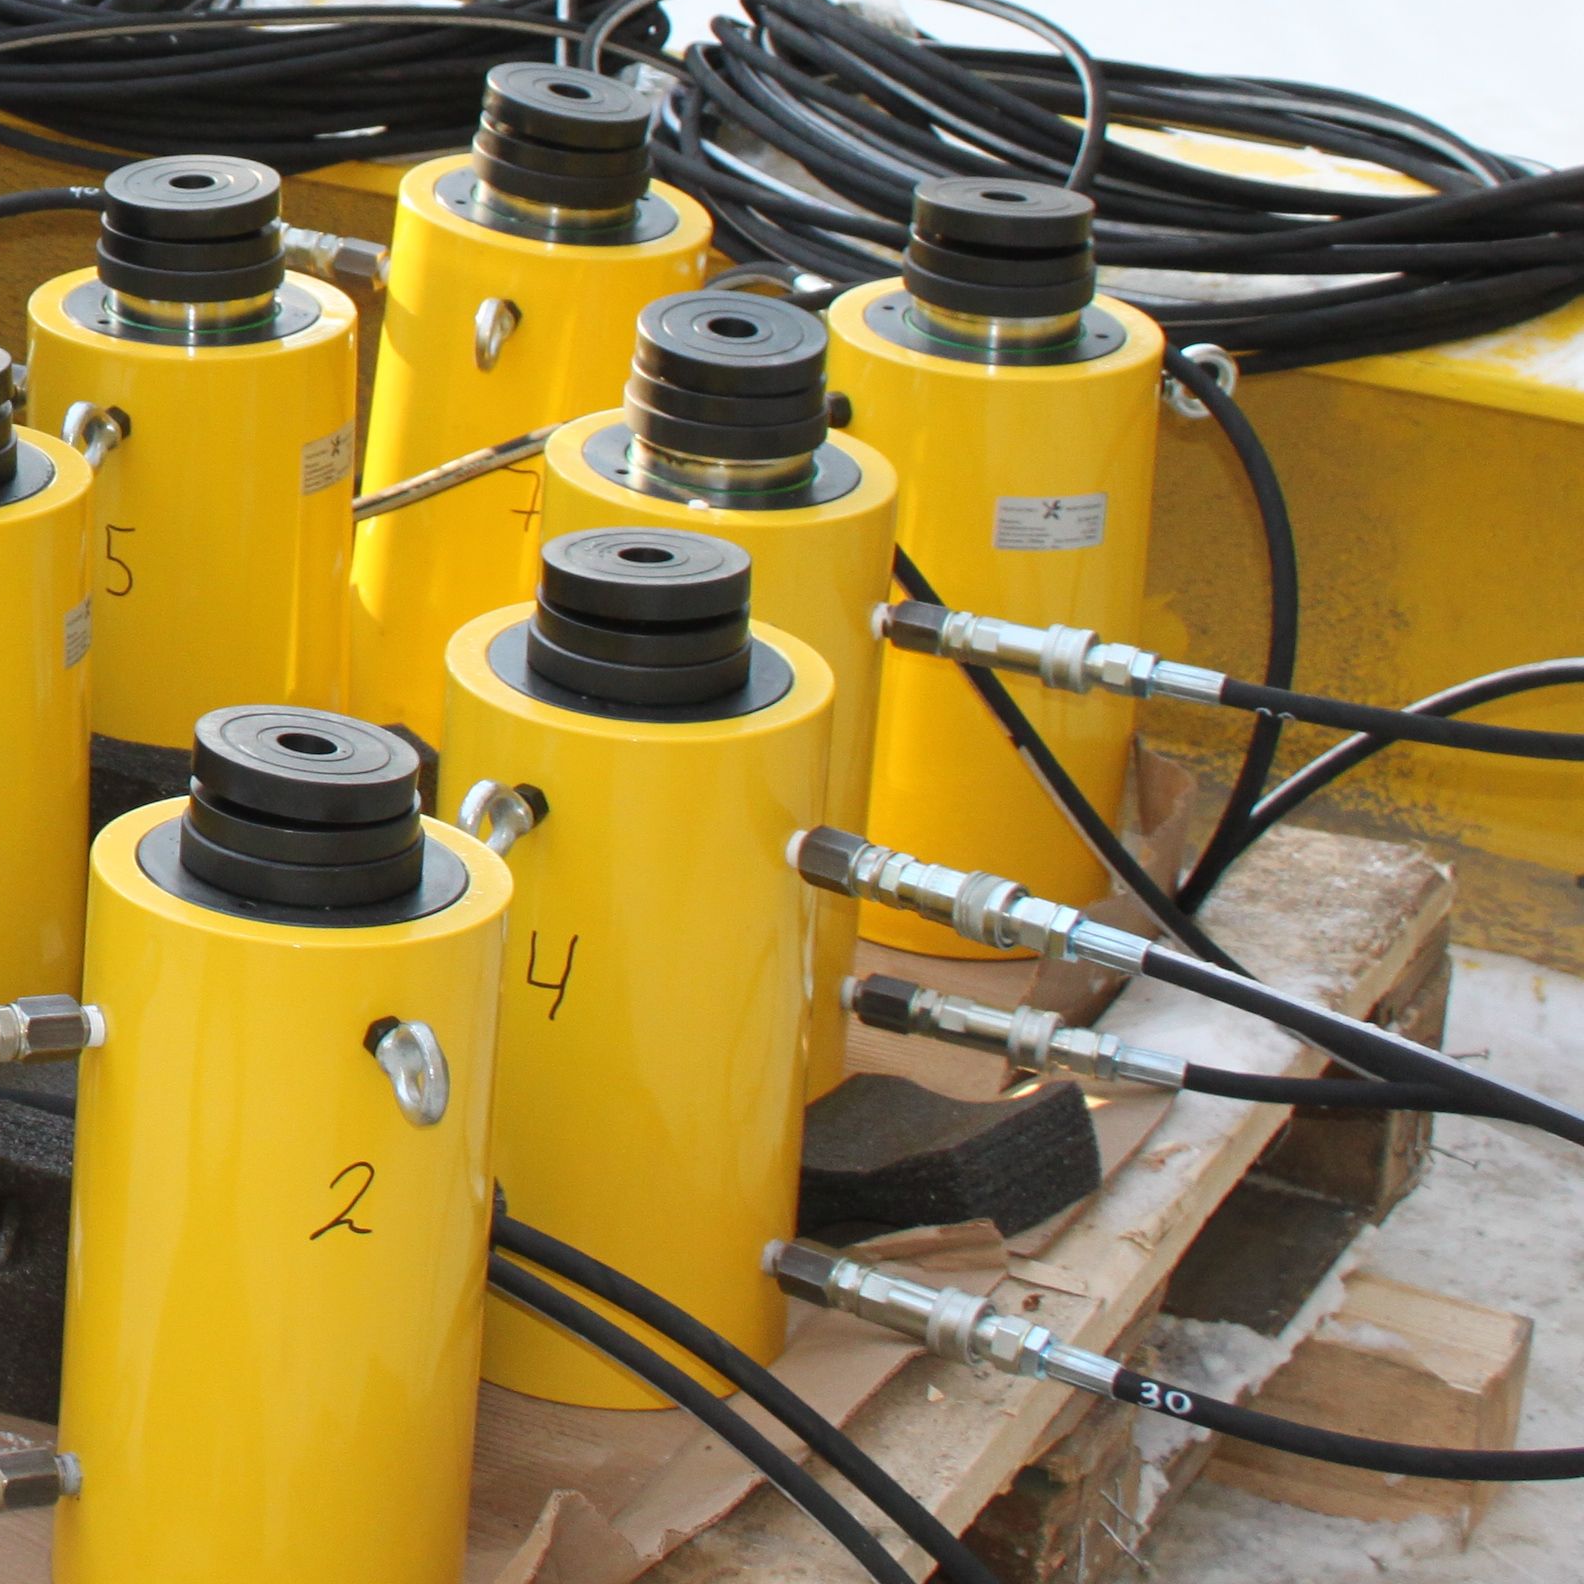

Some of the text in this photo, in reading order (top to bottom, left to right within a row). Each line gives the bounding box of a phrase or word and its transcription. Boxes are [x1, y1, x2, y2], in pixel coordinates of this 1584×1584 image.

[499, 464, 541, 532] 7
[105, 523, 137, 597] 5
[527, 929, 578, 1021] 4
[309, 1161, 375, 1241] 2
[1137, 1381, 1193, 1415] 30
